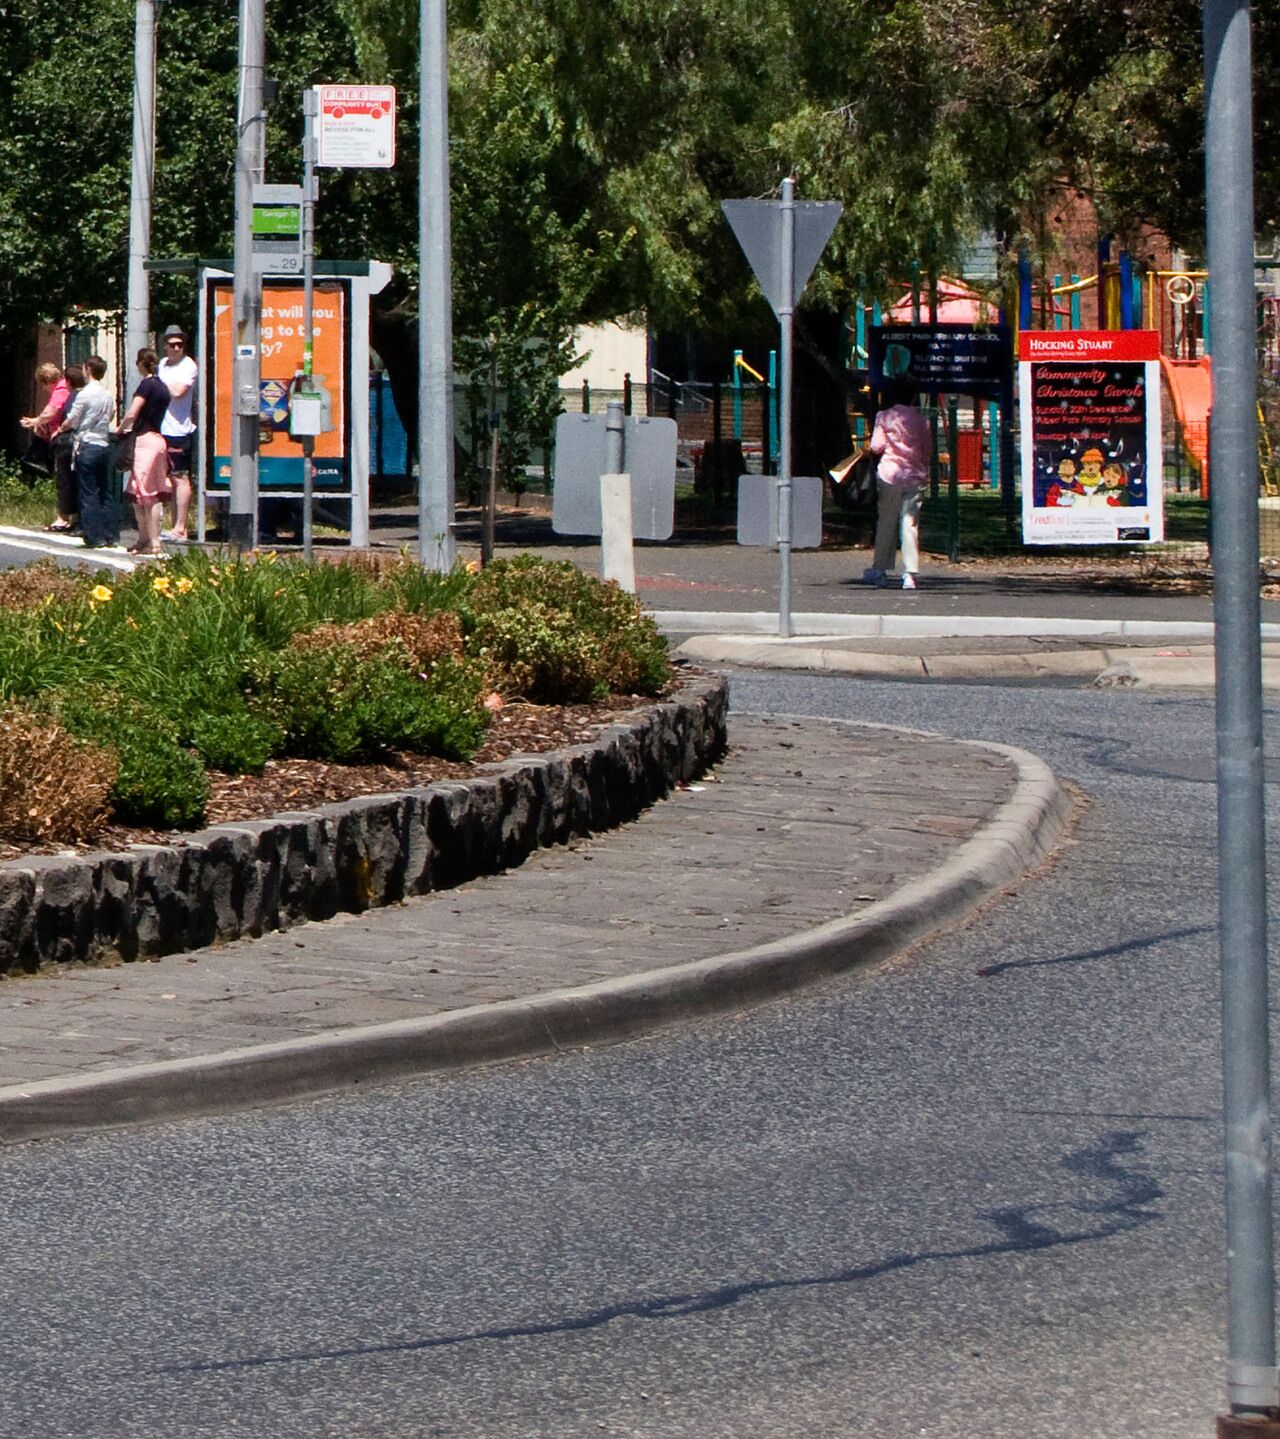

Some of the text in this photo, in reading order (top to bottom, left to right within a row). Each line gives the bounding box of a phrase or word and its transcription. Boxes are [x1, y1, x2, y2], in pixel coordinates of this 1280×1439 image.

[282, 258, 297, 269] 29
[278, 305, 303, 318] will
[310, 309, 334, 319] ou
[277, 326, 294, 337] to
[297, 326, 321, 337] te
[1036, 367, 1107, 384] Community
